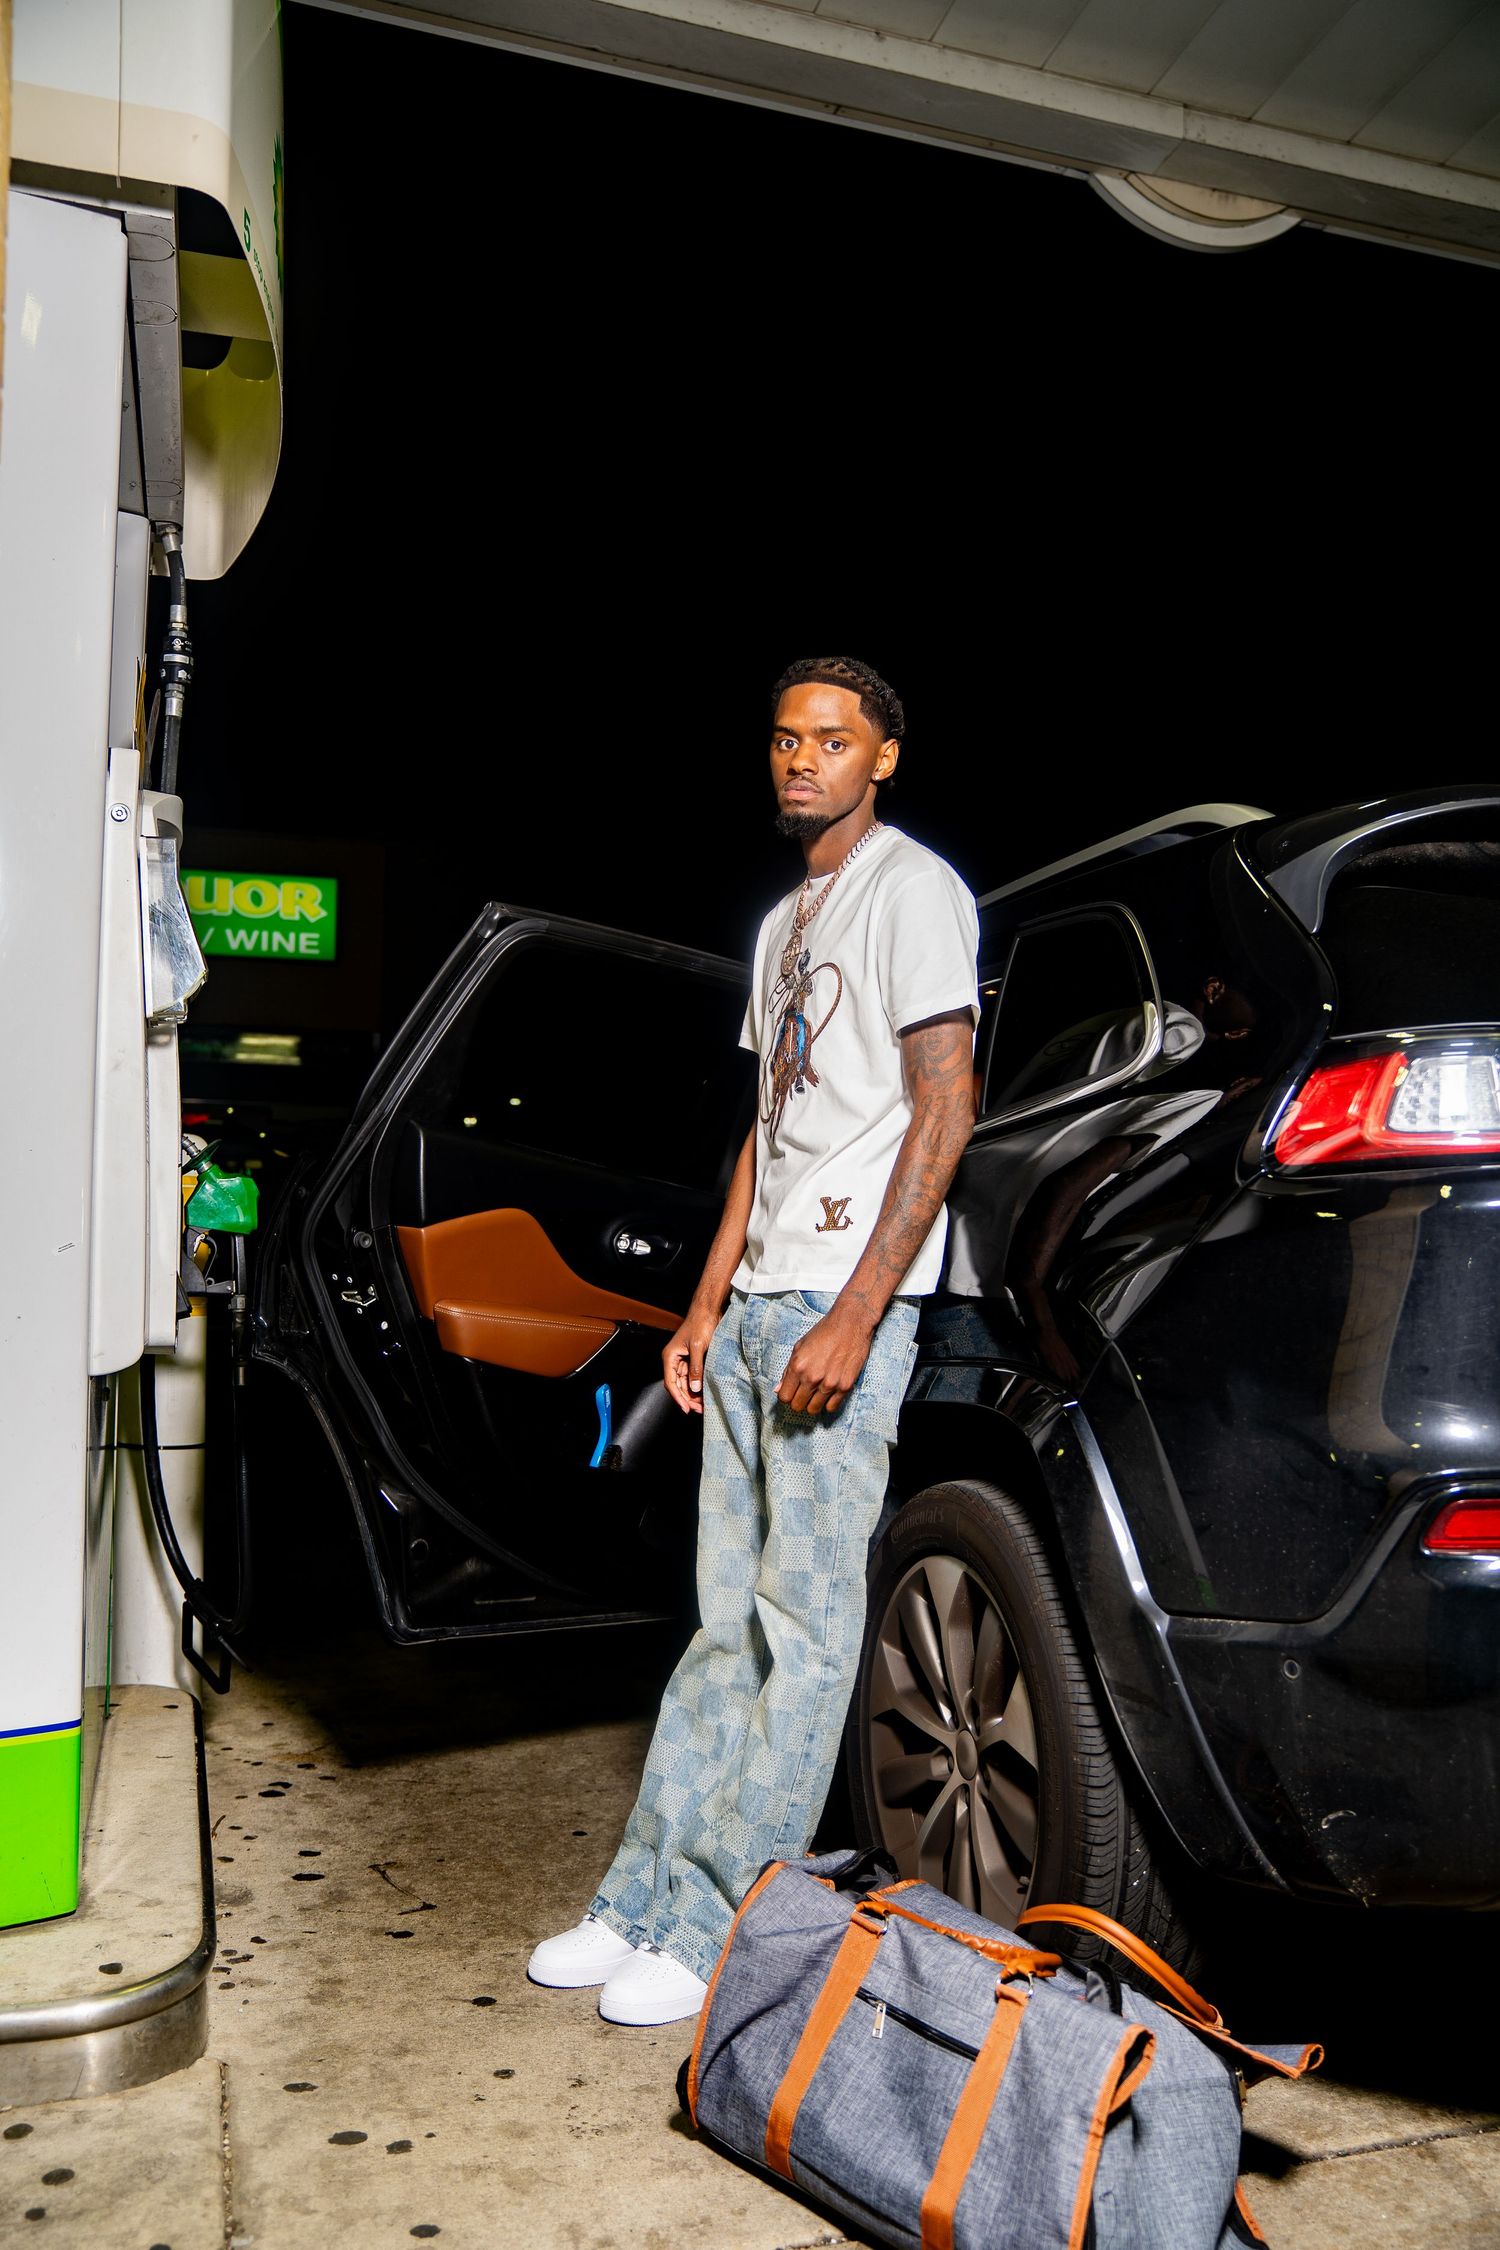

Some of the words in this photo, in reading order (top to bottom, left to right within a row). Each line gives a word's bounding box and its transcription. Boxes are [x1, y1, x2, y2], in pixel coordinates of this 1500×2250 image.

[243, 206, 251, 252] 5
[183, 876, 327, 922] UOR
[225, 929, 320, 955] WINE
